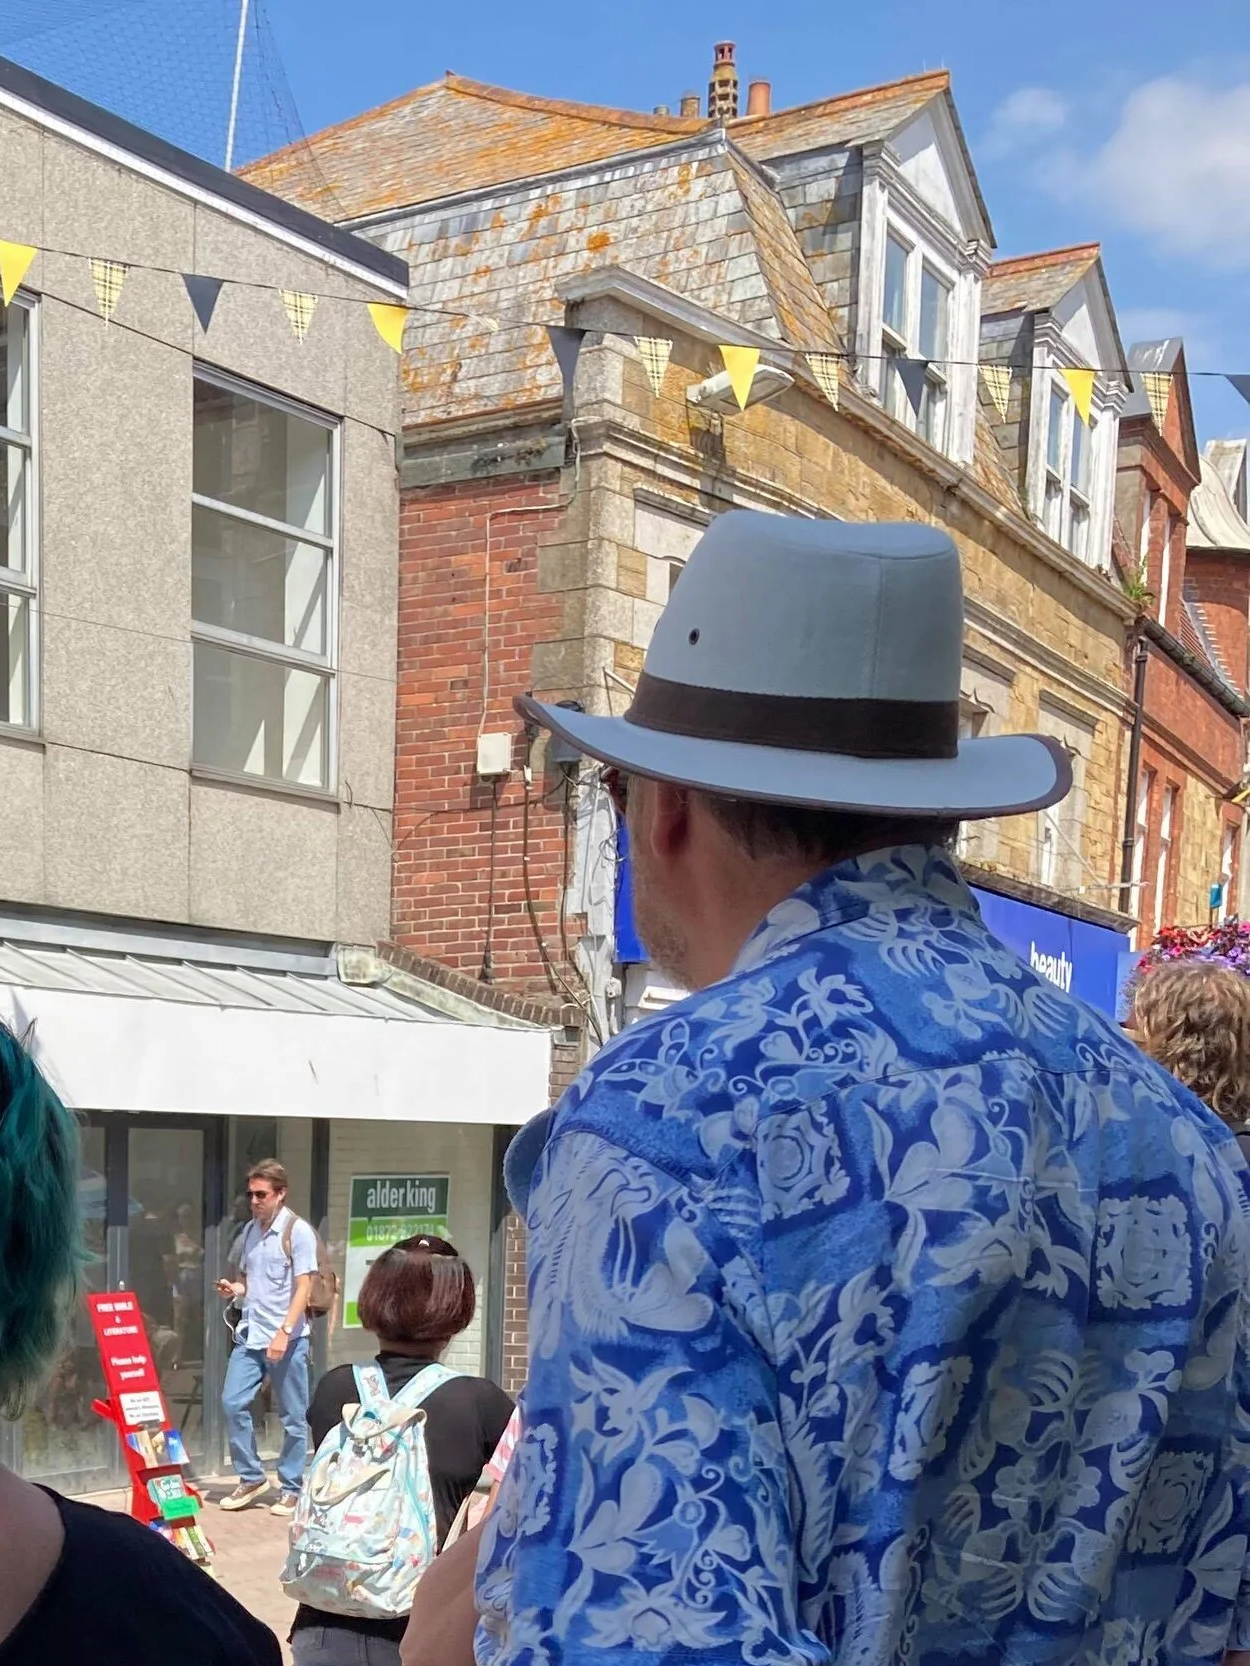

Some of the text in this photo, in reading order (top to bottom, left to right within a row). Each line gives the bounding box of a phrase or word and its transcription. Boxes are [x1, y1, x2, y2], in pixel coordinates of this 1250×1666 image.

[1030, 940, 1073, 993] beauty
[366, 1179, 436, 1213] alder king
[365, 1224, 397, 1242] 01872
